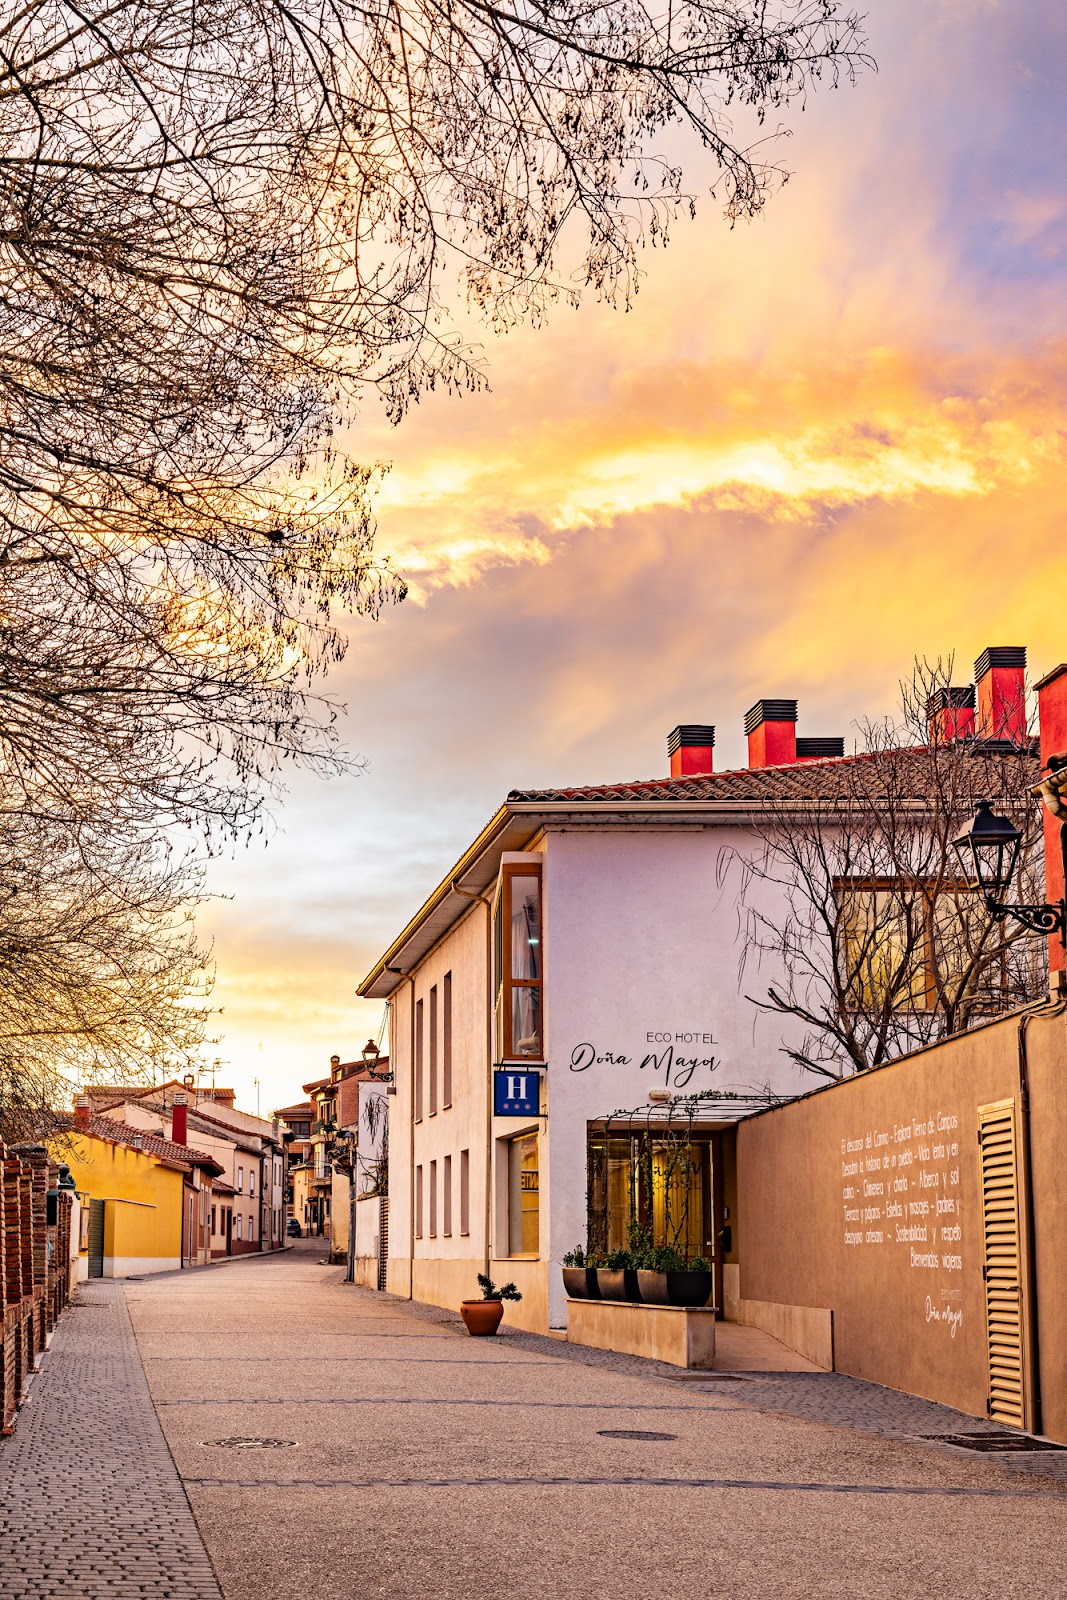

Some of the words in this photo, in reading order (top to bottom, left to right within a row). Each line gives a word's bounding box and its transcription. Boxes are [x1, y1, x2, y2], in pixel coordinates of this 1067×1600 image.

[646, 1032, 672, 1043] ECO
[675, 1032, 718, 1044] HOTEL
[569, 1042, 632, 1072] Doña
[639, 1045, 721, 1088] Mayor
[506, 1076, 527, 1099] H
[873, 1130, 889, 1147] Camino
[893, 1124, 911, 1143] Explorar
[912, 1118, 926, 1136] Tierra
[928, 1115, 934, 1133] de
[936, 1111, 958, 1134] Campos
[866, 1154, 881, 1171] historia
[883, 1152, 889, 1168] de
[898, 1149, 912, 1169] pueblo
[918, 1144, 930, 1161] Vida
[932, 1142, 944, 1159] lenta
[951, 1142, 958, 1156] en
[919, 1170, 939, 1188] Alberca
[950, 1165, 959, 1185] sol
[885, 1200, 902, 1218] Estrellas
[936, 1193, 954, 1216] Jardines
[932, 1228, 936, 1245] y
[941, 1223, 961, 1245] respeto
[941, 1253, 962, 1273] viajeros
